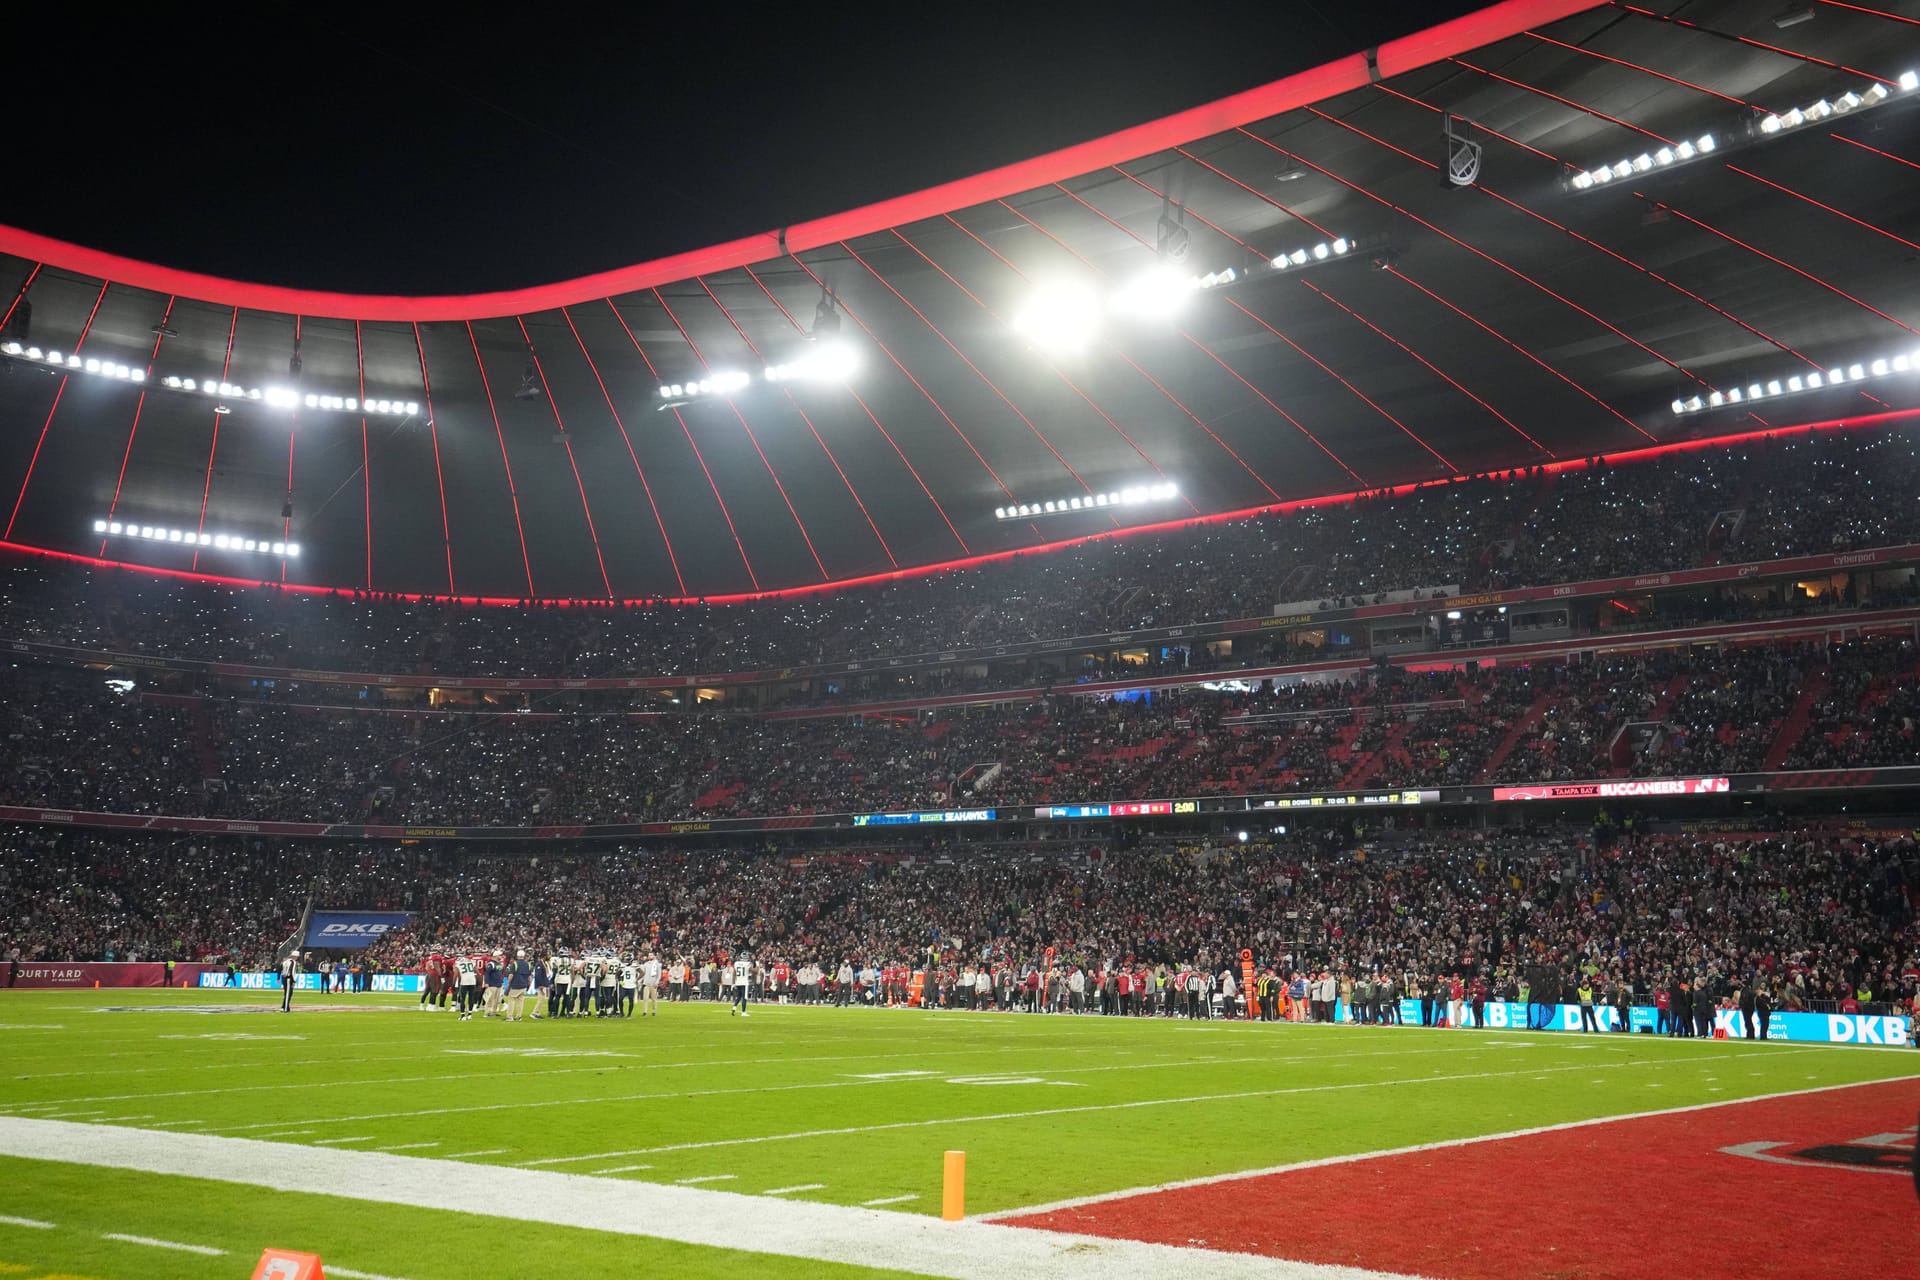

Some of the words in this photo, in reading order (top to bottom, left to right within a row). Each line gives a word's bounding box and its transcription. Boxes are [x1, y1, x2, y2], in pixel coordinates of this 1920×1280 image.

[1635, 577, 1659, 587] Allianz
[1553, 587, 1570, 595] DKB
[1444, 597, 1477, 609] MUNICH
[1478, 594, 1502, 606] GAME
[1261, 616, 1289, 627] MUNICH
[1169, 629, 1183, 637] VISA
[1554, 788, 1579, 796] TAMPA
[1581, 787, 1593, 795] BAY
[1600, 780, 1685, 796] BUCCANEERS
[1174, 802, 1195, 813] 2:00
[944, 810, 988, 822] SEAHAWKS
[671, 824, 693, 832] MUNICH
[693, 822, 711, 831] GAME
[405, 829, 434, 837] MUNICH
[322, 924, 390, 933] DKB
[8, 969, 82, 978] OURTYARD
[460, 963, 475, 974] 30
[586, 963, 600, 974] 57
[736, 966, 746, 977] 51
[203, 972, 224, 987] DKB
[241, 972, 264, 988] DKB
[372, 974, 396, 991] DKB
[1633, 1007, 1648, 1016] Das
[1633, 1017, 1653, 1025] kann
[1715, 1029, 1724, 1038] 10
[1767, 1031, 1789, 1040] Bank
[1828, 1014, 1906, 1046] DKB
